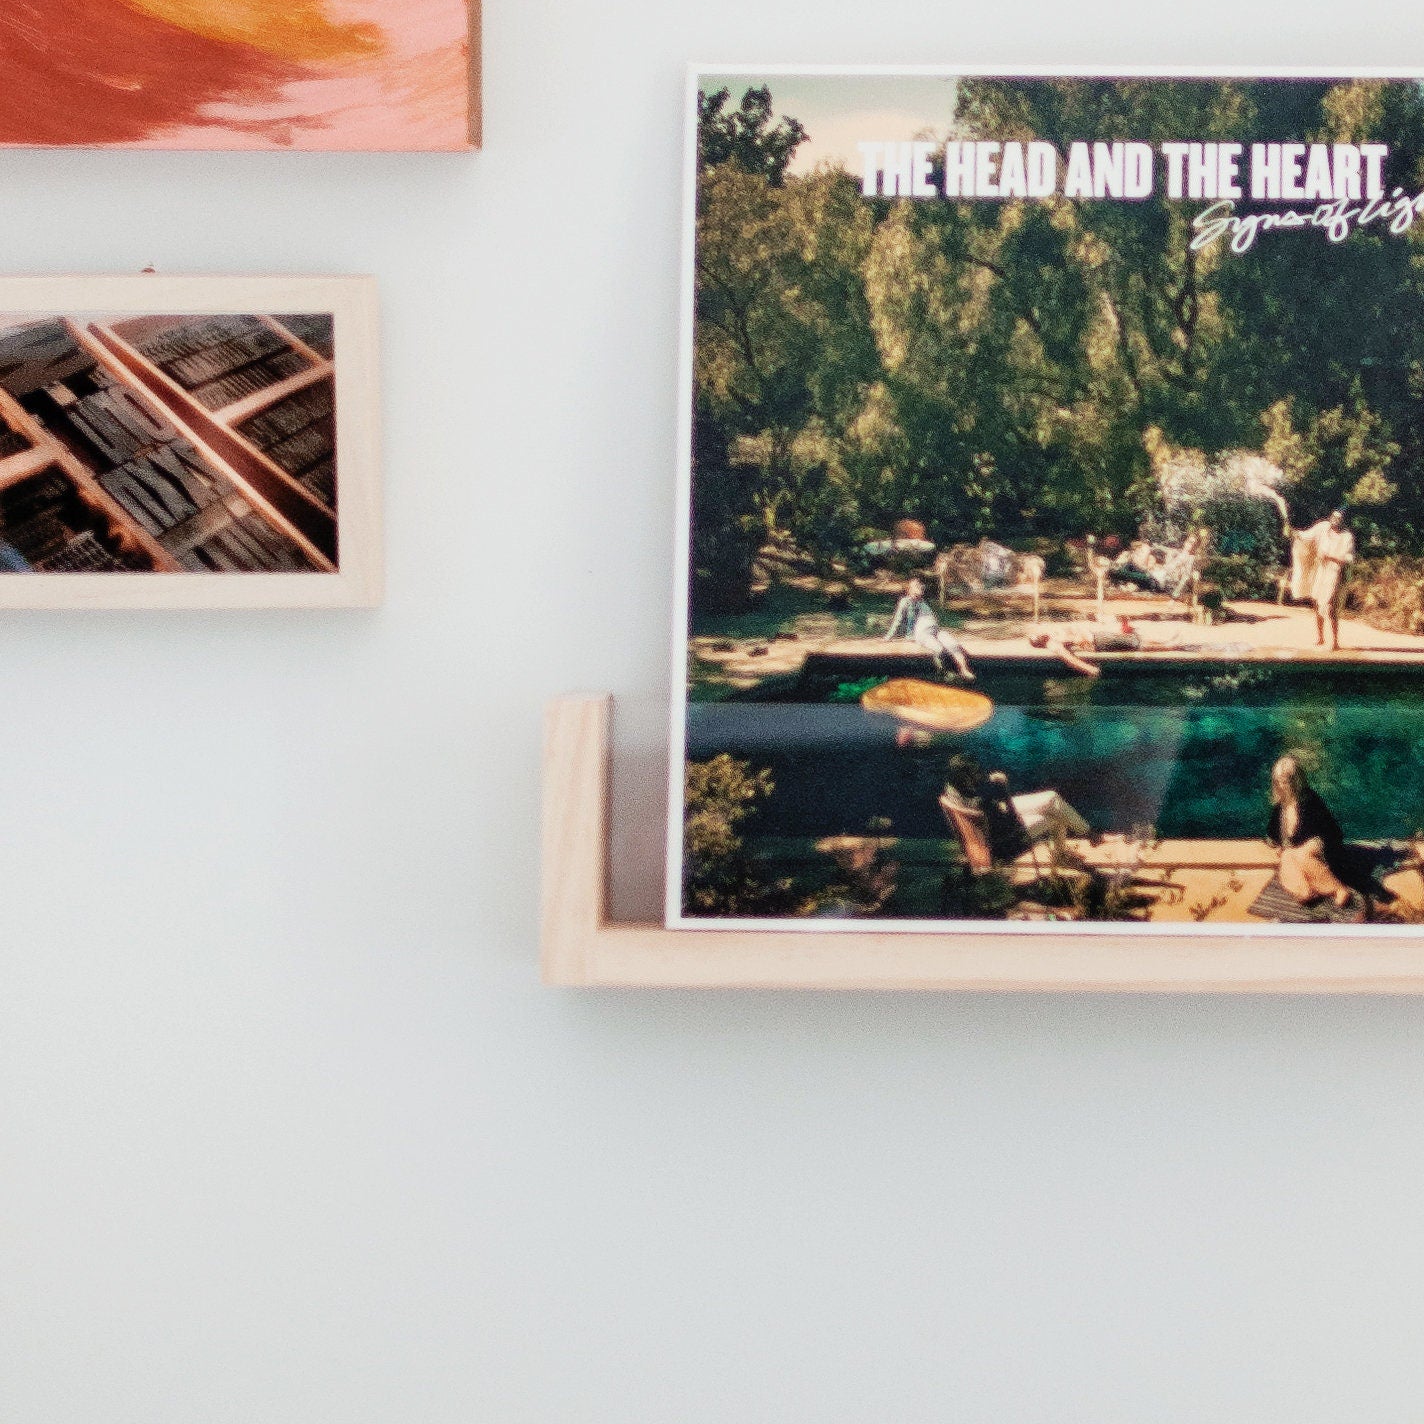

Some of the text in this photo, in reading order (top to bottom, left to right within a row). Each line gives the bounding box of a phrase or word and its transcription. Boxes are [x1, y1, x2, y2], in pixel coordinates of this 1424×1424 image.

[858, 141, 1388, 199] THE HEAD AND THE HEART
[1189, 200, 1307, 254] Signs
[1311, 196, 1357, 243] of
